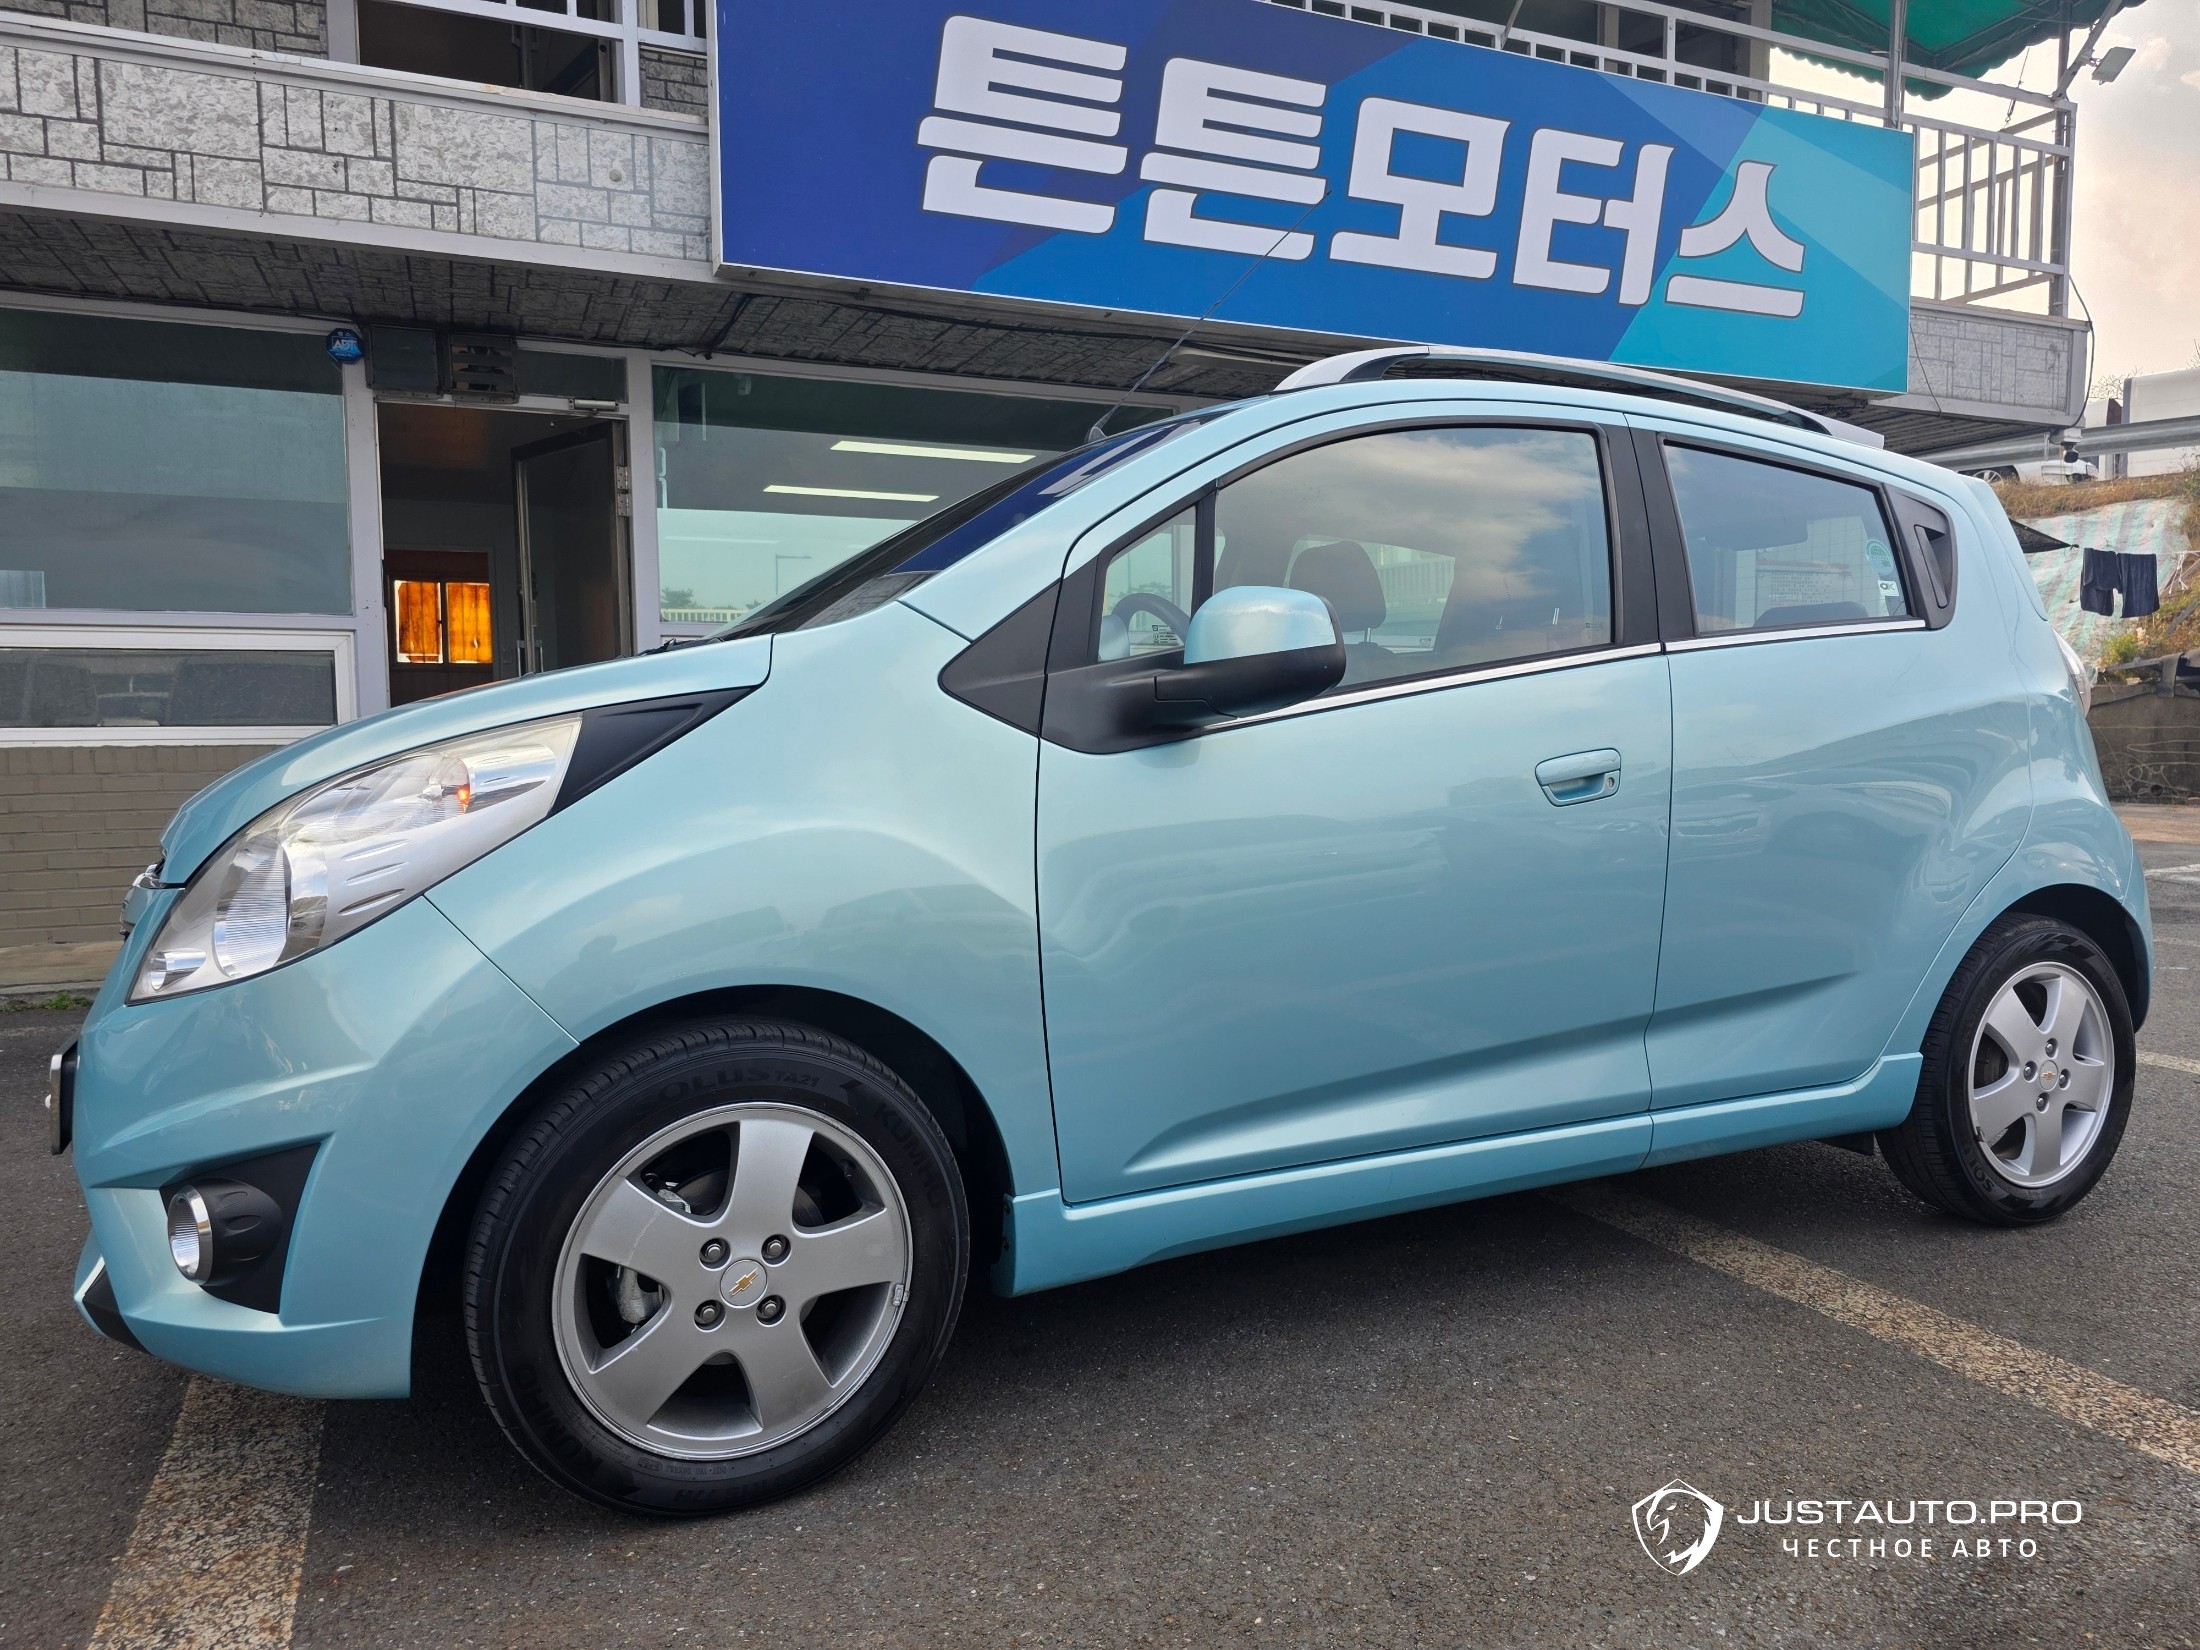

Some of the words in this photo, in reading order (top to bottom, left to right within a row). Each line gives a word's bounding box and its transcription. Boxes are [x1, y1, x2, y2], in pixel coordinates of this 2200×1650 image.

[917, 14, 1807, 318] 튼튼모터스
[333, 339, 355, 350] ADT
[872, 1103, 943, 1209] KUMHO
[514, 1363, 603, 1476] KUMHO
